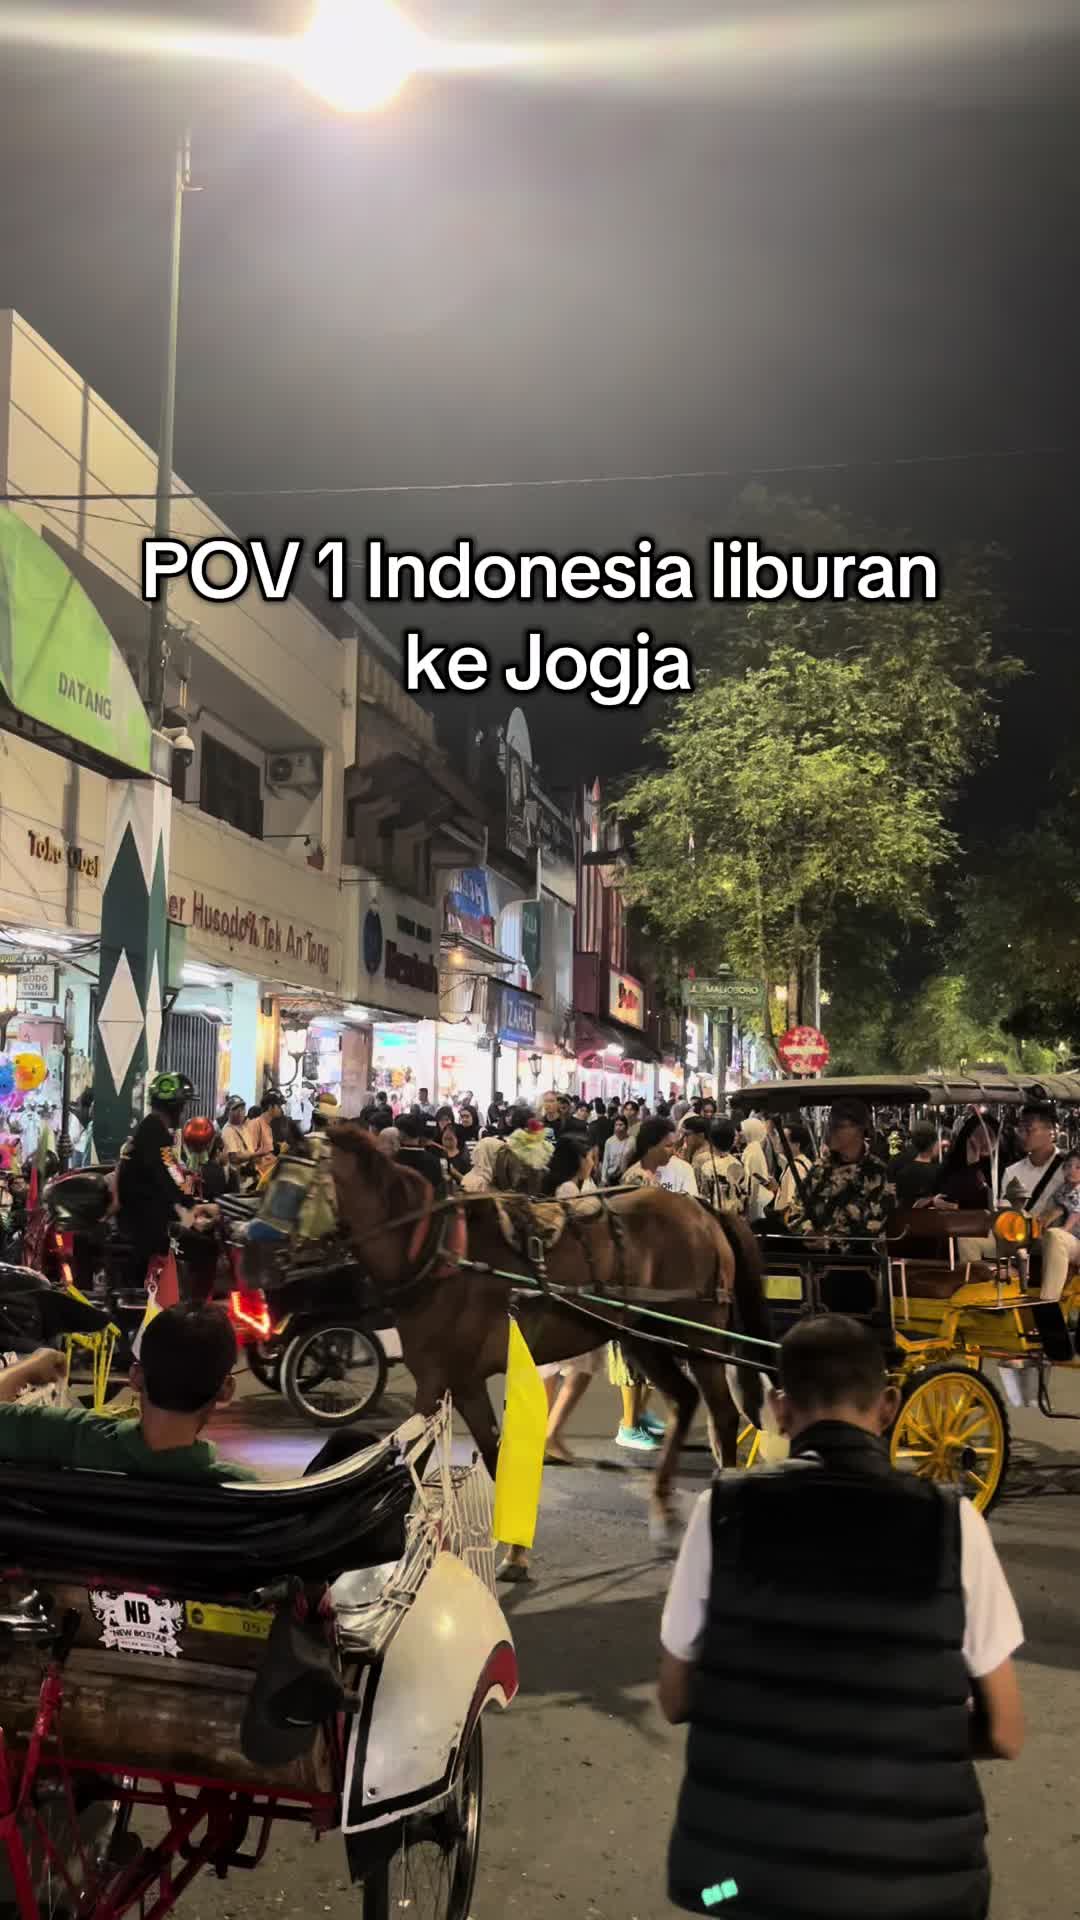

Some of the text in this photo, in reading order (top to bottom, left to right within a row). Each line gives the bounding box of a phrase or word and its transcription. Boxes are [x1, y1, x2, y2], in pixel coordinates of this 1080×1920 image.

[58, 671, 112, 720] DATANG
[28, 830, 62, 864] Toko
[124, 1599, 151, 1625] NB
